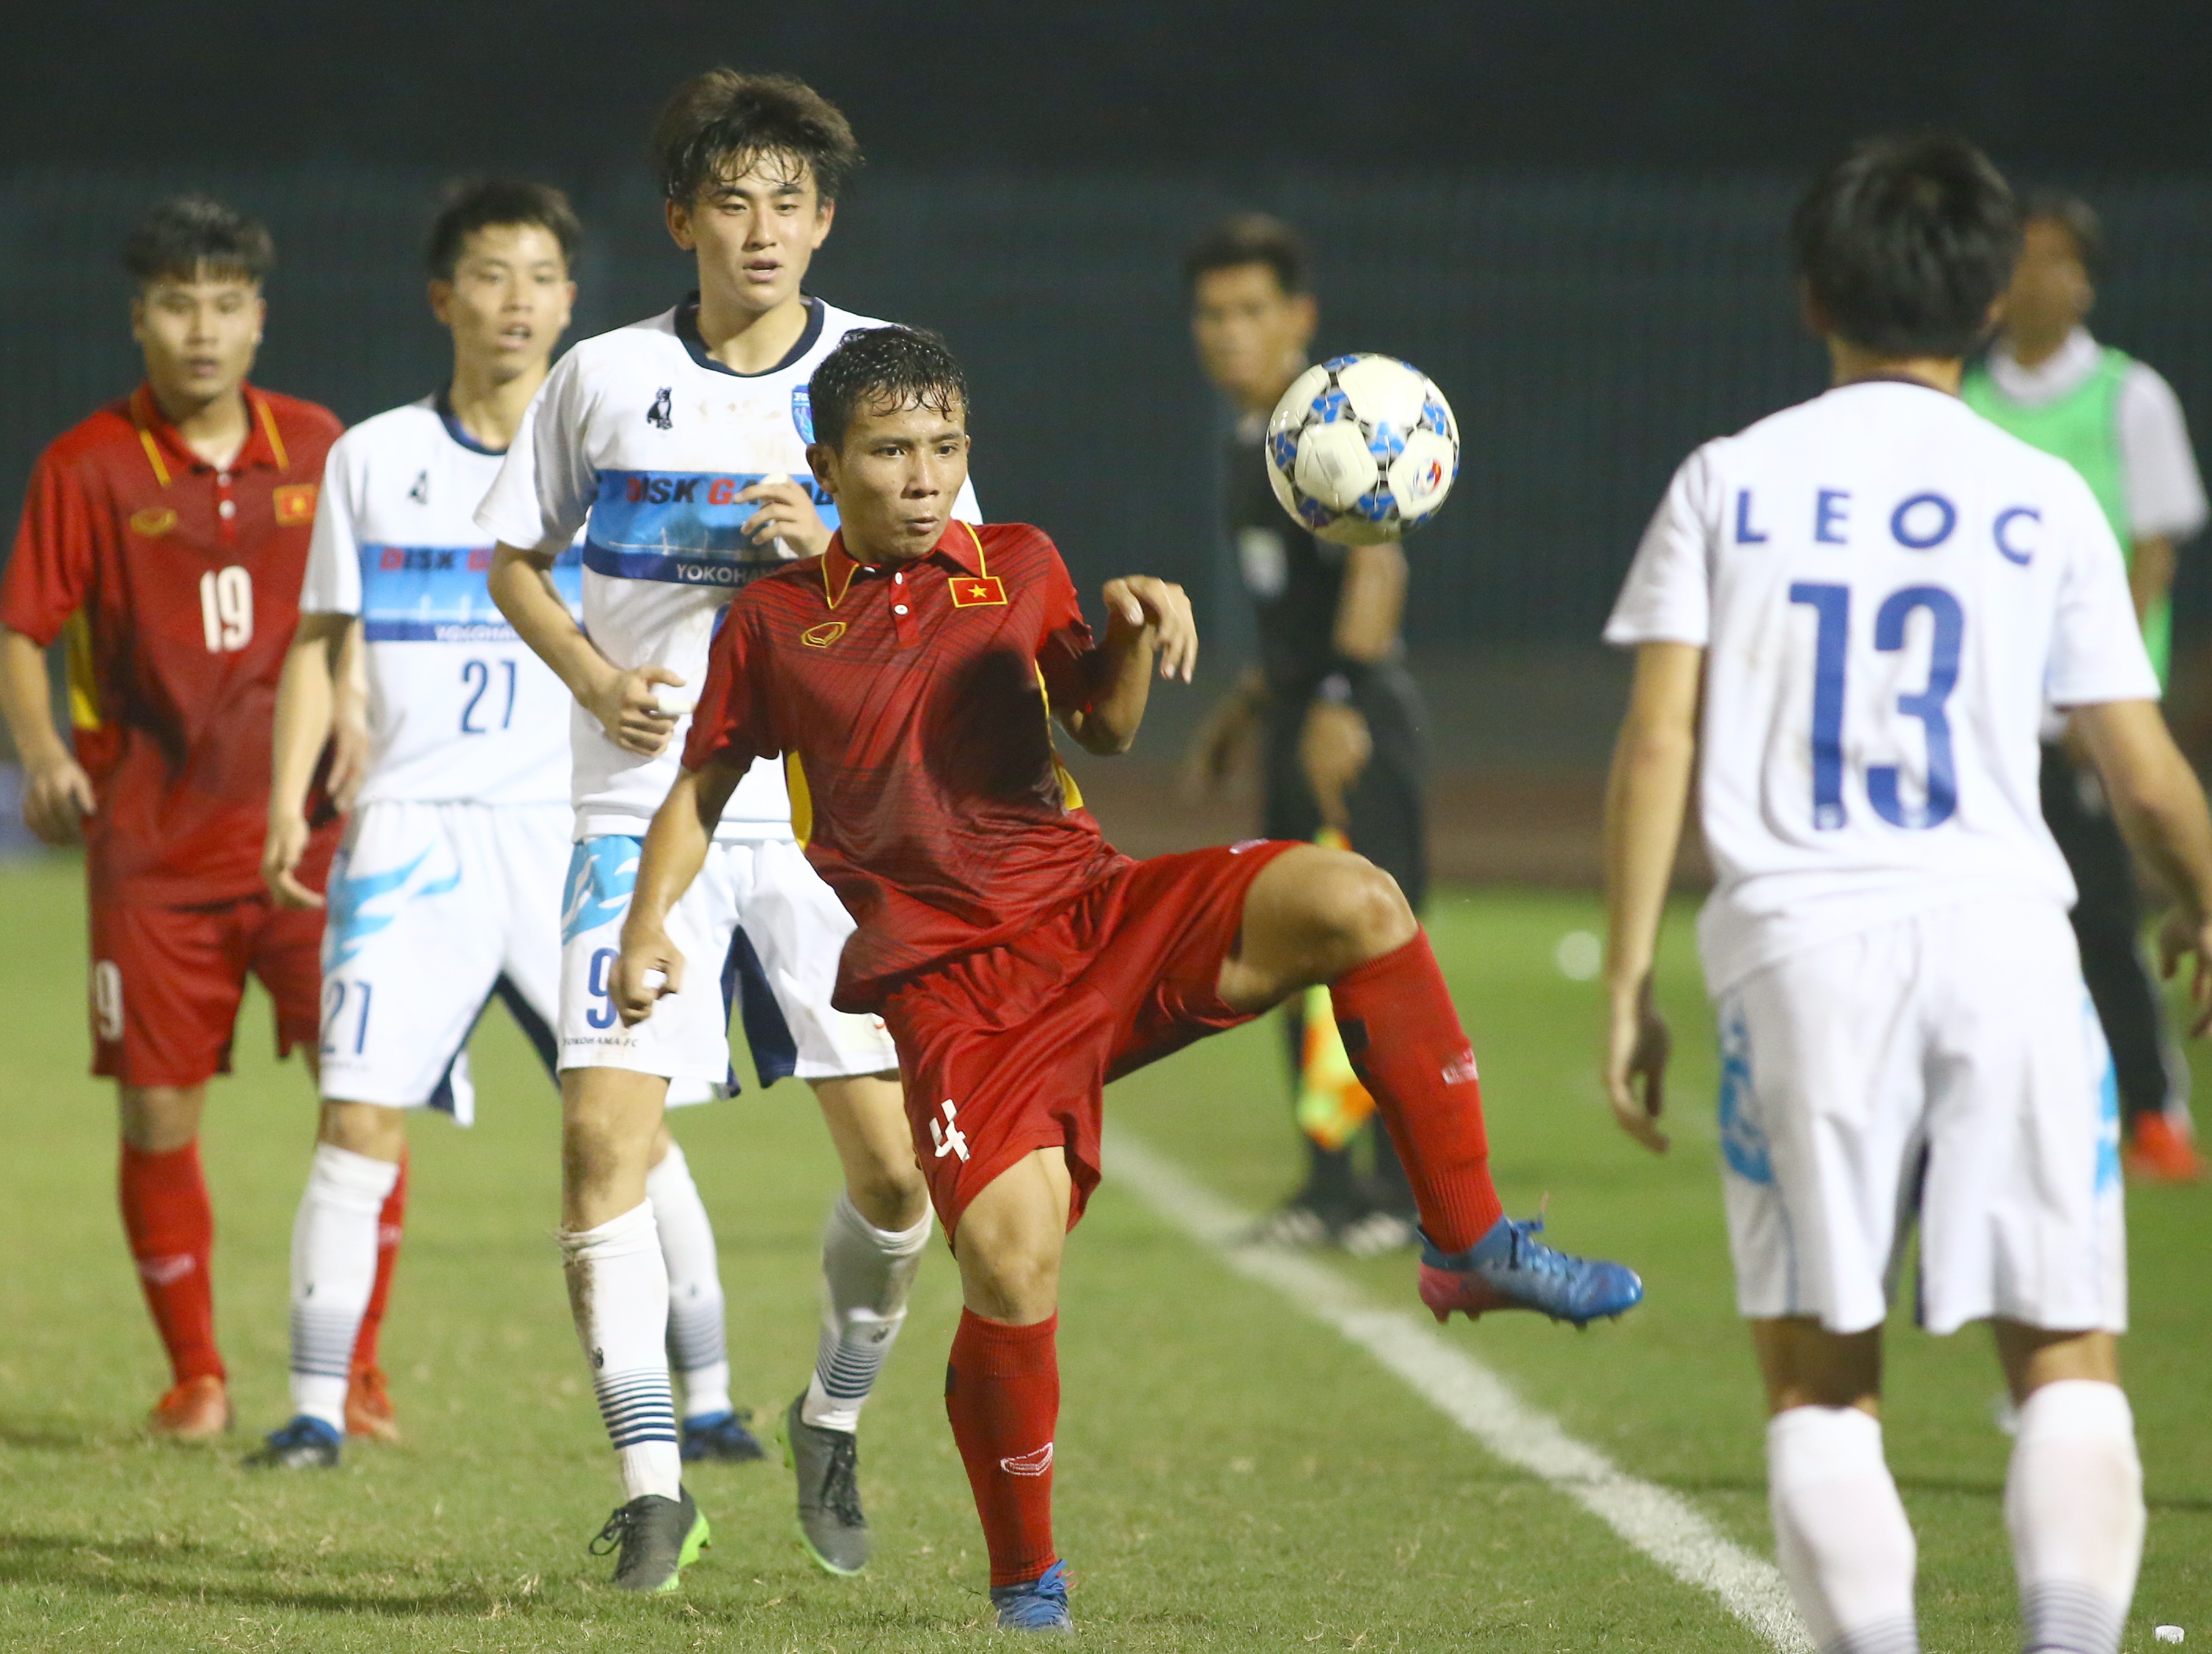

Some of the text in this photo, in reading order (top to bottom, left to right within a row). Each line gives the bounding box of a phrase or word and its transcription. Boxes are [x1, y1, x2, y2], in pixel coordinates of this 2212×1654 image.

[626, 476, 699, 503] DISK
[1735, 489, 2041, 567] LEOC
[200, 565, 253, 652] 19
[461, 659, 516, 733] 21
[1789, 582, 1965, 832] 13
[320, 980, 372, 1054] 21
[586, 947, 621, 1029] 9
[929, 1098, 971, 1163] 4
